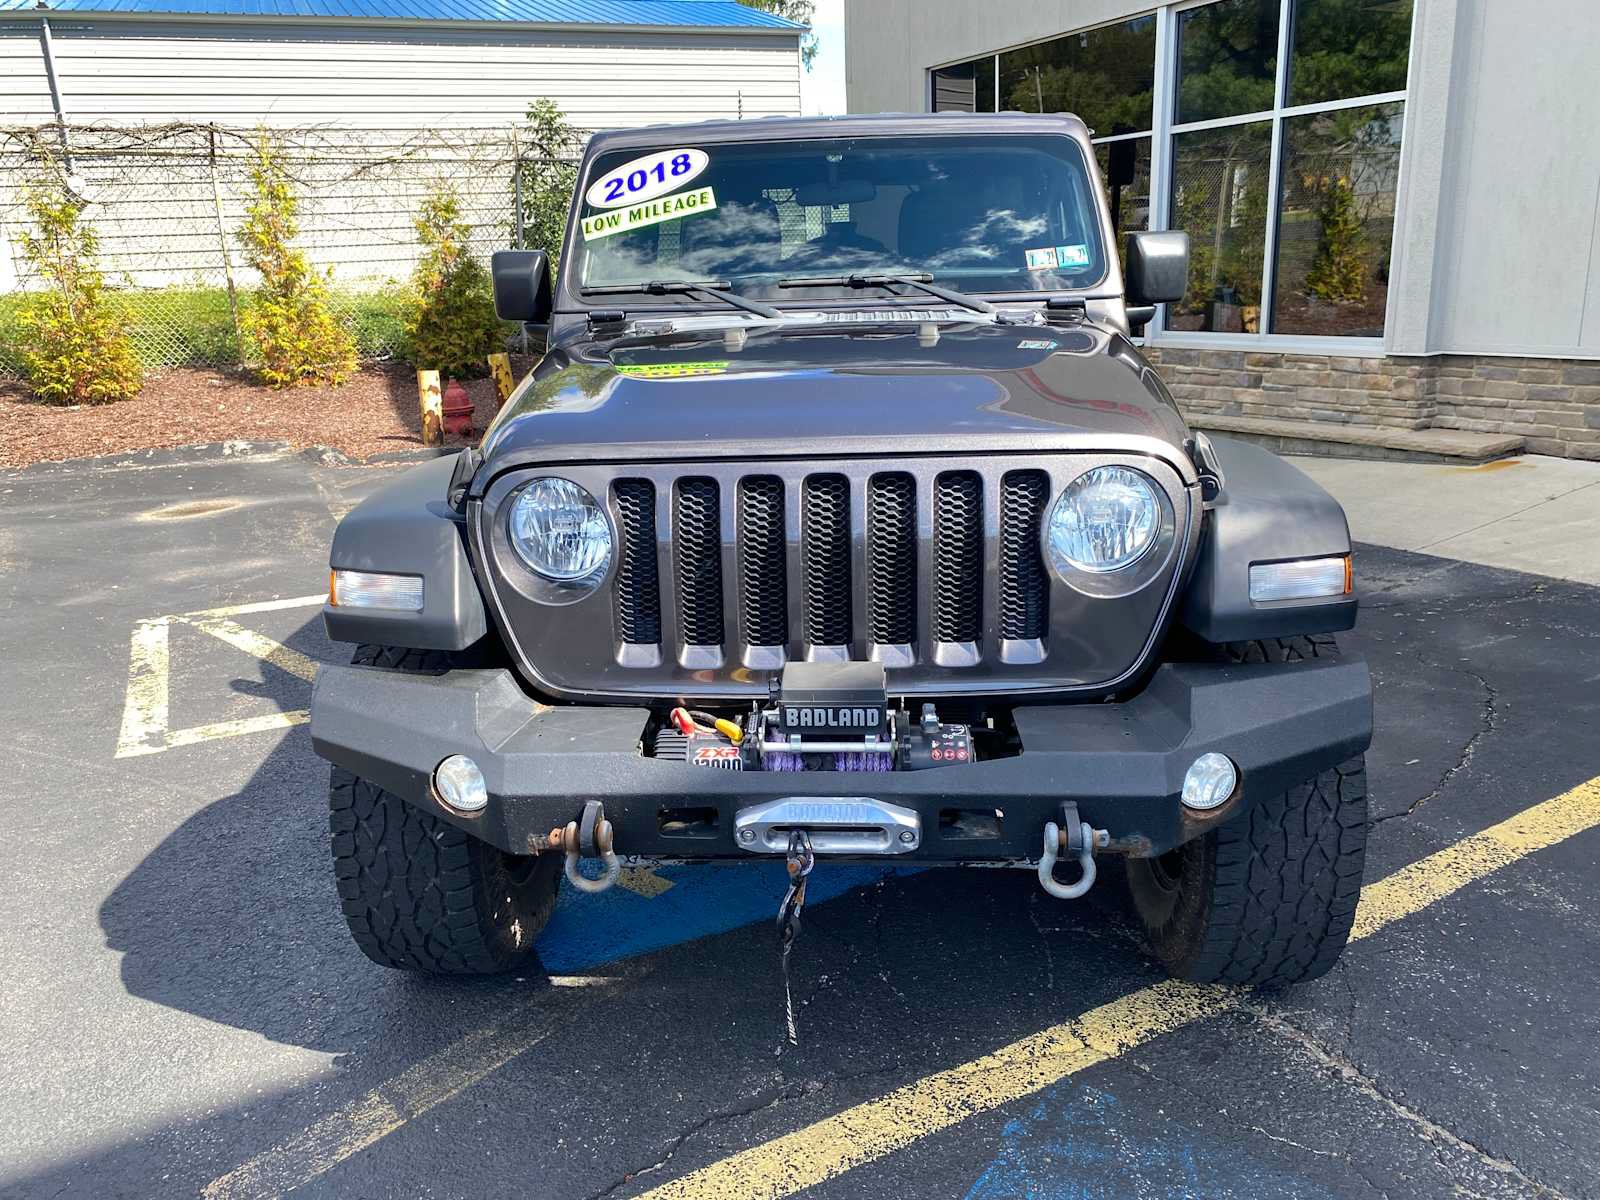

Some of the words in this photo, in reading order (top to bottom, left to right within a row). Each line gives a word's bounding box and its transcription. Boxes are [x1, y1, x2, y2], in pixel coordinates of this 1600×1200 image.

[605, 153, 692, 202] 2018
[585, 214, 621, 234] LOW
[629, 191, 709, 222] MILEAGE
[785, 708, 880, 727] BADLAND
[697, 747, 739, 758] ZXR
